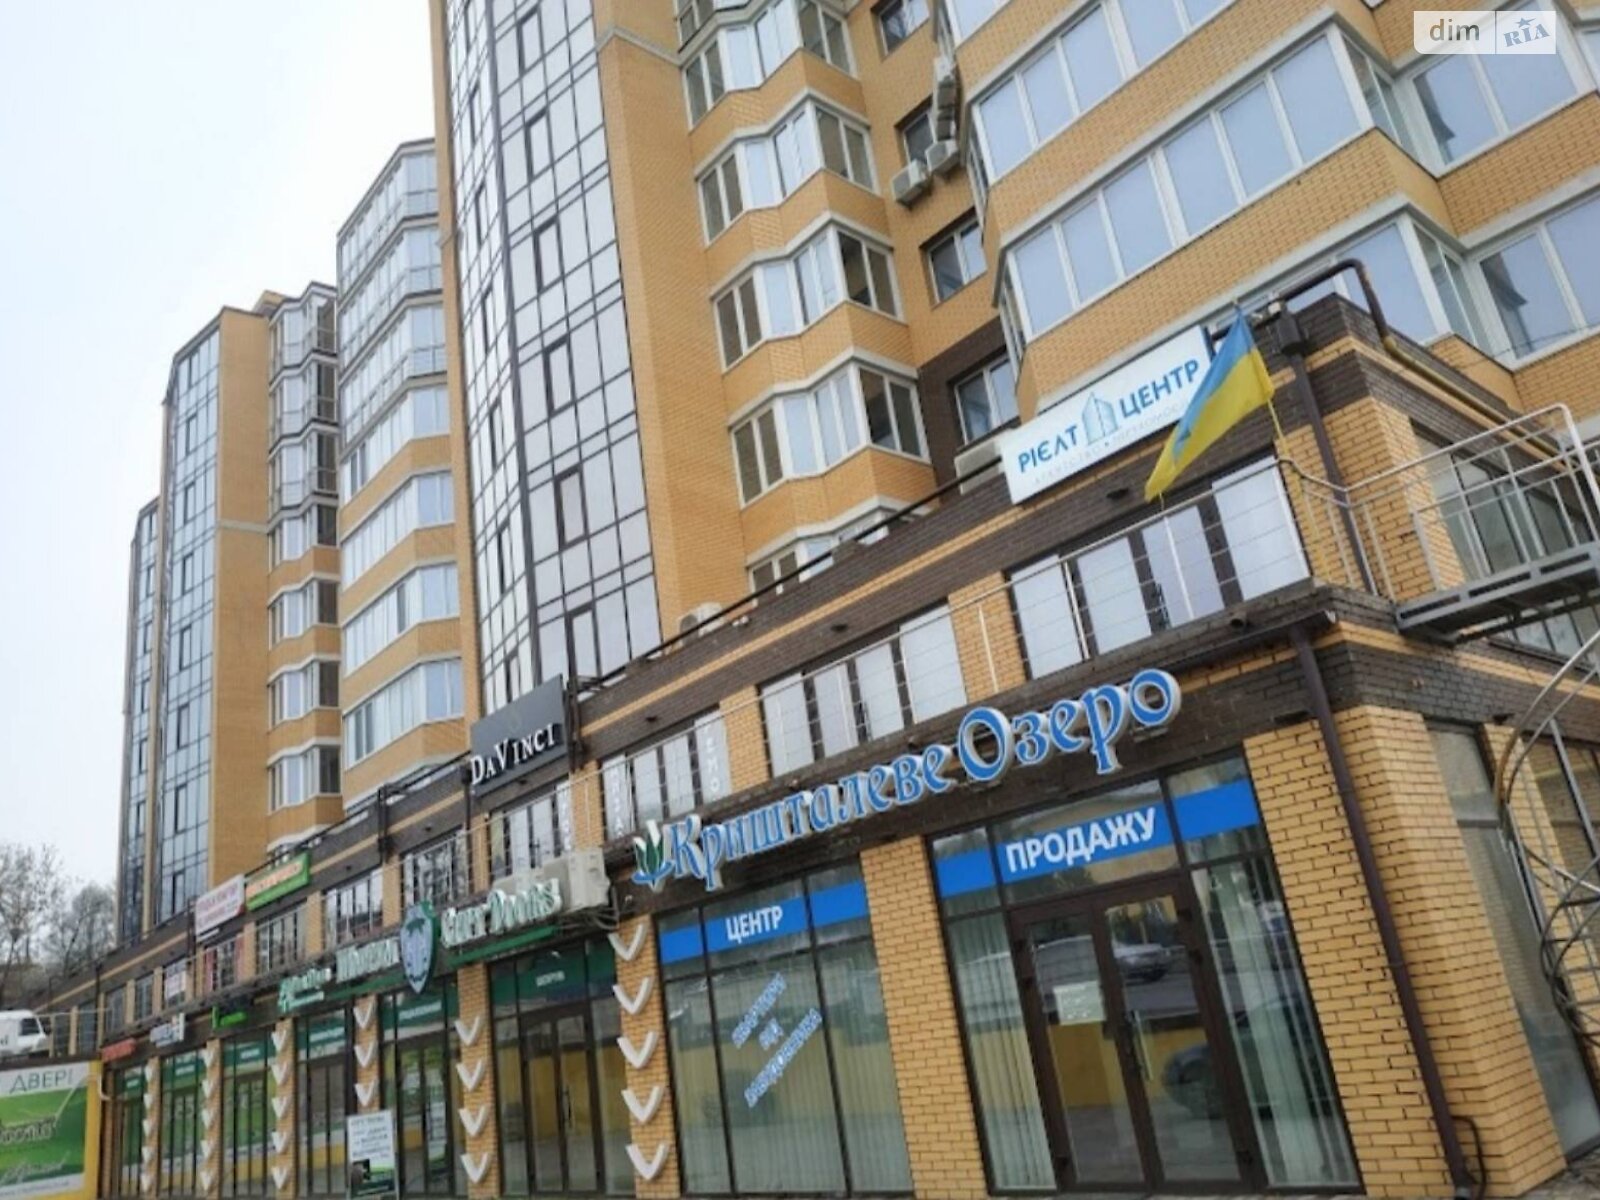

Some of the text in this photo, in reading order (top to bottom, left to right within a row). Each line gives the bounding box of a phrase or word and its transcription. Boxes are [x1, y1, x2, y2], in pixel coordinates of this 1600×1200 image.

[1119, 359, 1200, 419] ЦЕНТР
[669, 740, 953, 890] Кришталеве
[957, 668, 1181, 783] Озеро
[1006, 807, 1156, 874] ПРОДАЖУ
[725, 904, 784, 943] ЦЕНТР
